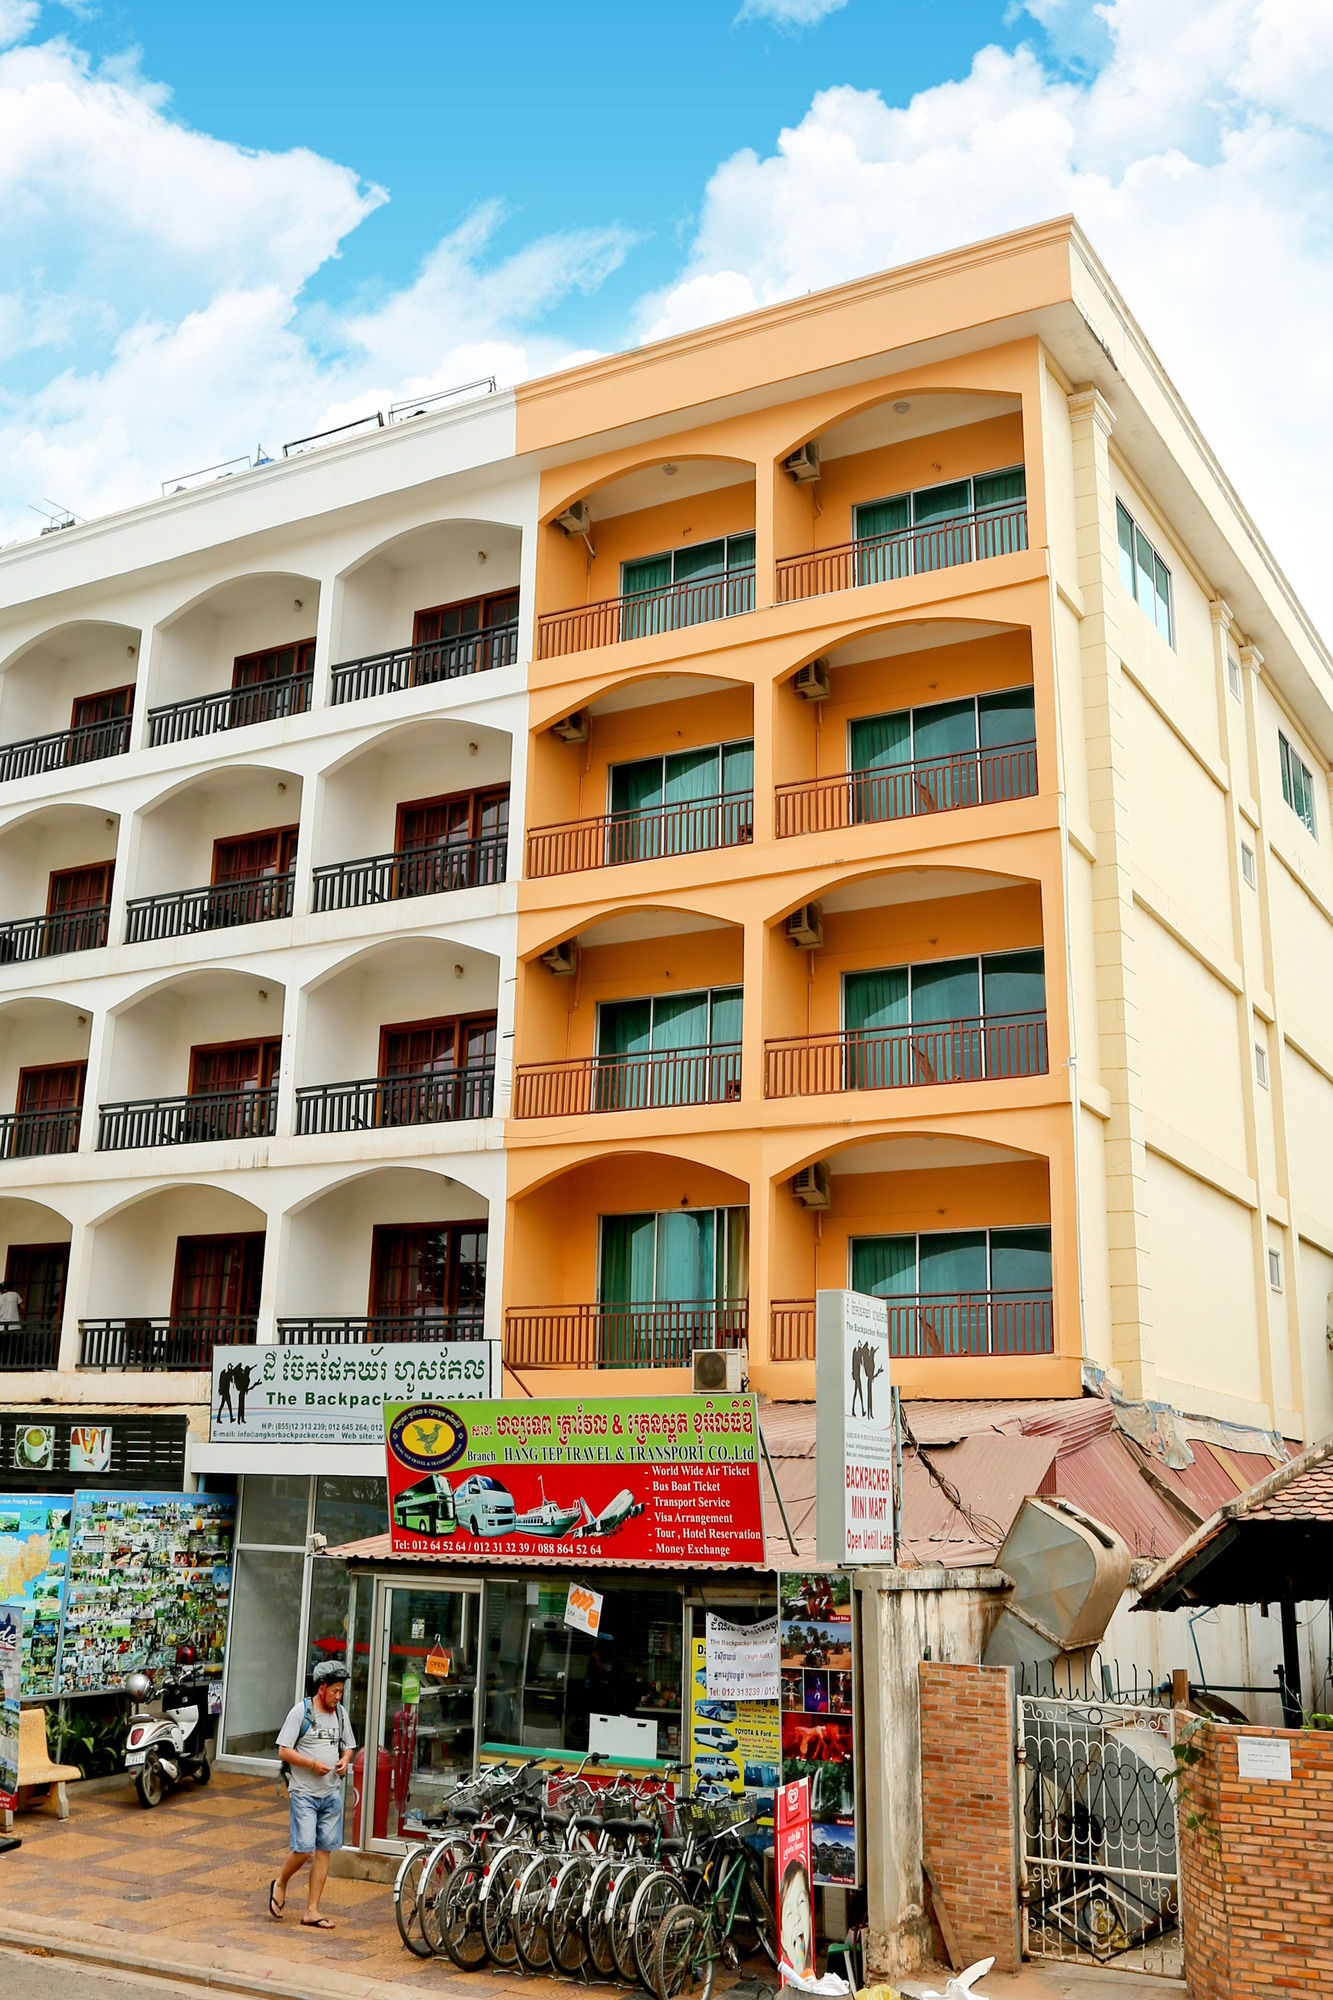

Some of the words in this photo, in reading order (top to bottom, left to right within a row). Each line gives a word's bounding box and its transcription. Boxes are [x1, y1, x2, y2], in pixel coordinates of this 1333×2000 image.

[266, 1392, 297, 1405] The
[299, 1423, 313, 1431] 313
[327, 1423, 340, 1431] 012
[341, 1423, 354, 1431] 645
[370, 1424, 383, 1432] 012
[612, 1413, 624, 1435] &
[341, 1432, 357, 1440] Web
[467, 1450, 497, 1462] Branch
[504, 1447, 538, 1461] HANG
[564, 1446, 613, 1461] TRAVEL
[615, 1446, 625, 1460] &
[627, 1446, 705, 1461] TRANSPORT
[651, 1465, 679, 1476] World
[681, 1465, 704, 1476] Wide
[705, 1465, 720, 1476] Air
[721, 1465, 750, 1476] Ticket
[846, 1465, 890, 1491] BACKPACKER
[652, 1481, 669, 1491] Bus
[671, 1481, 691, 1491] Boat
[693, 1481, 720, 1491] Ticket
[653, 1496, 696, 1509] Transport
[698, 1497, 731, 1507] Service
[851, 1495, 867, 1519] MINI
[868, 1497, 887, 1520] MART
[654, 1512, 672, 1522] Visa
[674, 1512, 733, 1525] Arrangement
[655, 1527, 676, 1538] Tour
[682, 1528, 706, 1539] Hotel
[708, 1528, 761, 1539] Reservation
[394, 1539, 410, 1550] Tel:
[412, 1540, 428, 1550] 012
[430, 1540, 441, 1550] 64
[443, 1540, 454, 1551] 52
[455, 1541, 466, 1551] 64
[467, 1541, 472, 1551] /
[474, 1541, 490, 1552] 012
[492, 1542, 503, 1552] 31
[505, 1542, 516, 1552] 32
[518, 1542, 530, 1553] 39
[532, 1543, 536, 1553] /
[537, 1543, 555, 1554] 088
[557, 1543, 574, 1554] 864
[576, 1544, 587, 1555] 52
[590, 1544, 602, 1555] 64
[847, 1528, 862, 1554] Open
[880, 1530, 893, 1550] Late
[655, 1543, 685, 1556] Money
[687, 1543, 730, 1557] Exchange
[721, 1640, 752, 1648] Backpacker
[430, 1660, 446, 1669] OPEN
[709, 1687, 720, 1697] Tel:
[722, 1687, 735, 1697] 012
[737, 1687, 760, 1697] 313239
[764, 1687, 776, 1696] 012
